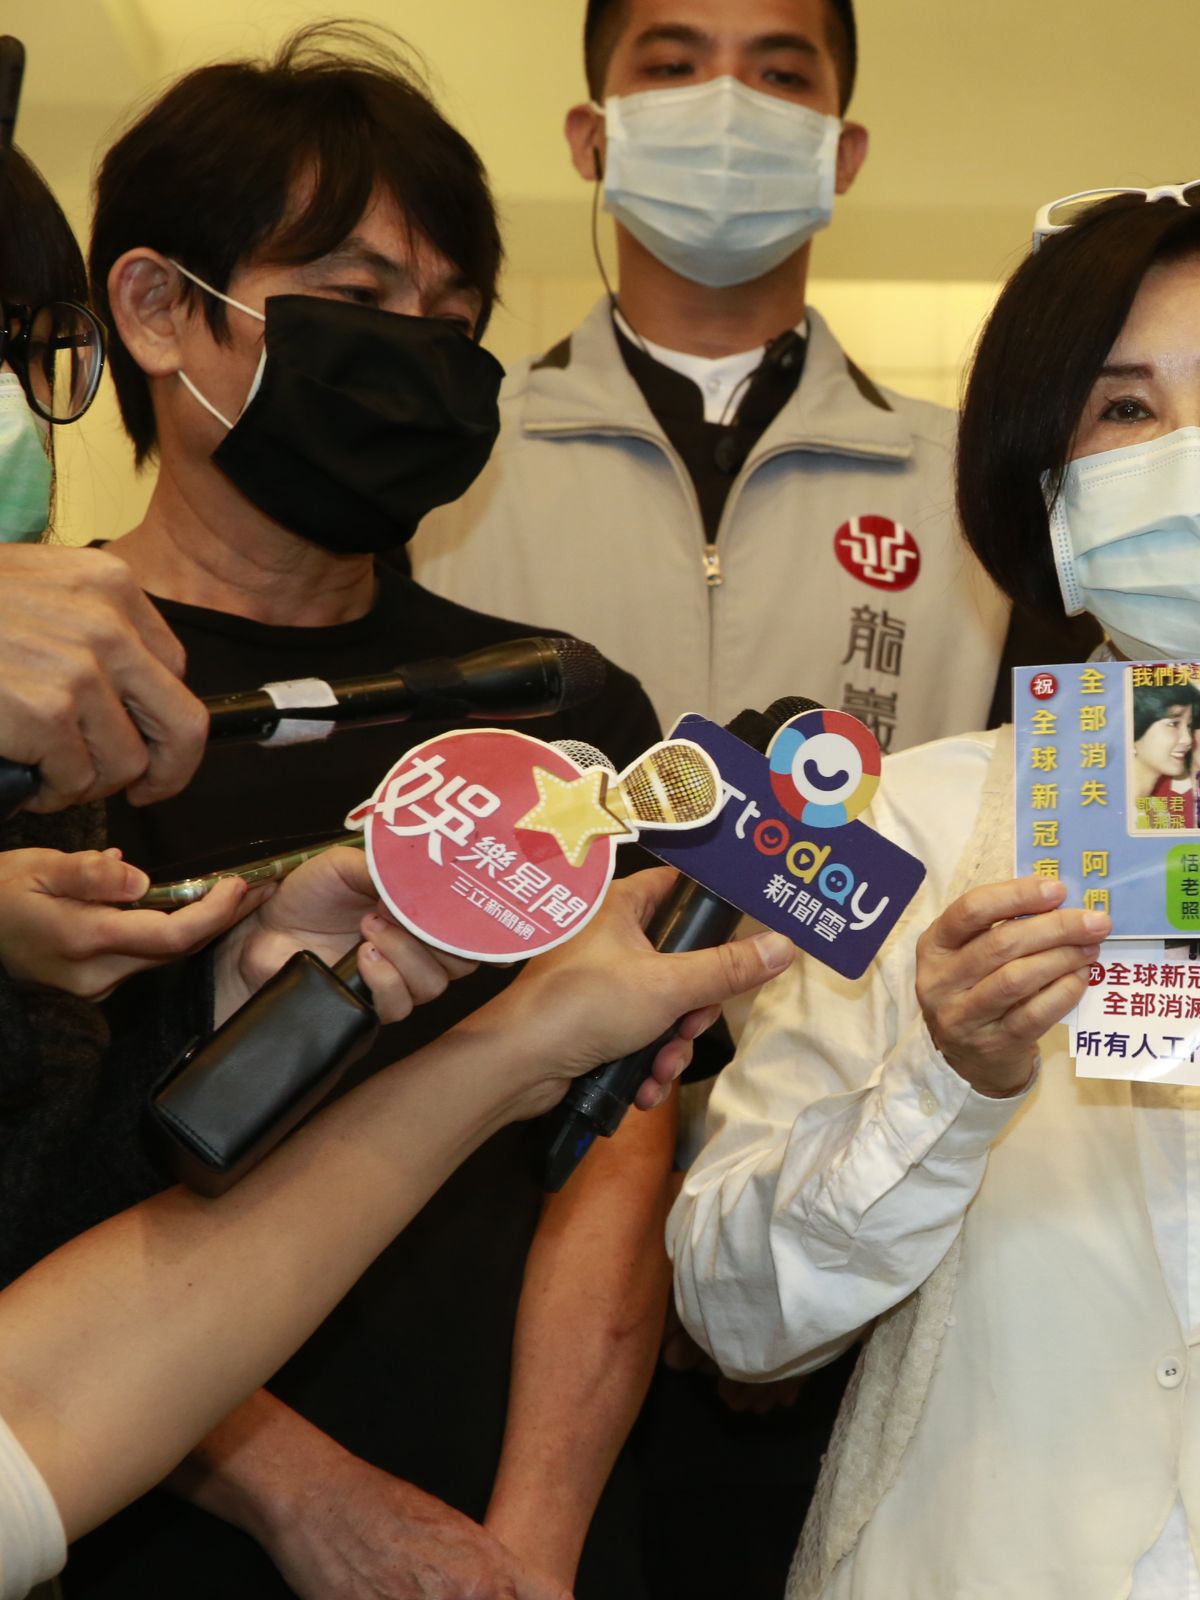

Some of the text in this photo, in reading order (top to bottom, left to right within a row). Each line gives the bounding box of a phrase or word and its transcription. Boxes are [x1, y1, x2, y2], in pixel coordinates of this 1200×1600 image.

[450, 875, 536, 941] 三立新聞網
[762, 873, 848, 943] 新聞雲
